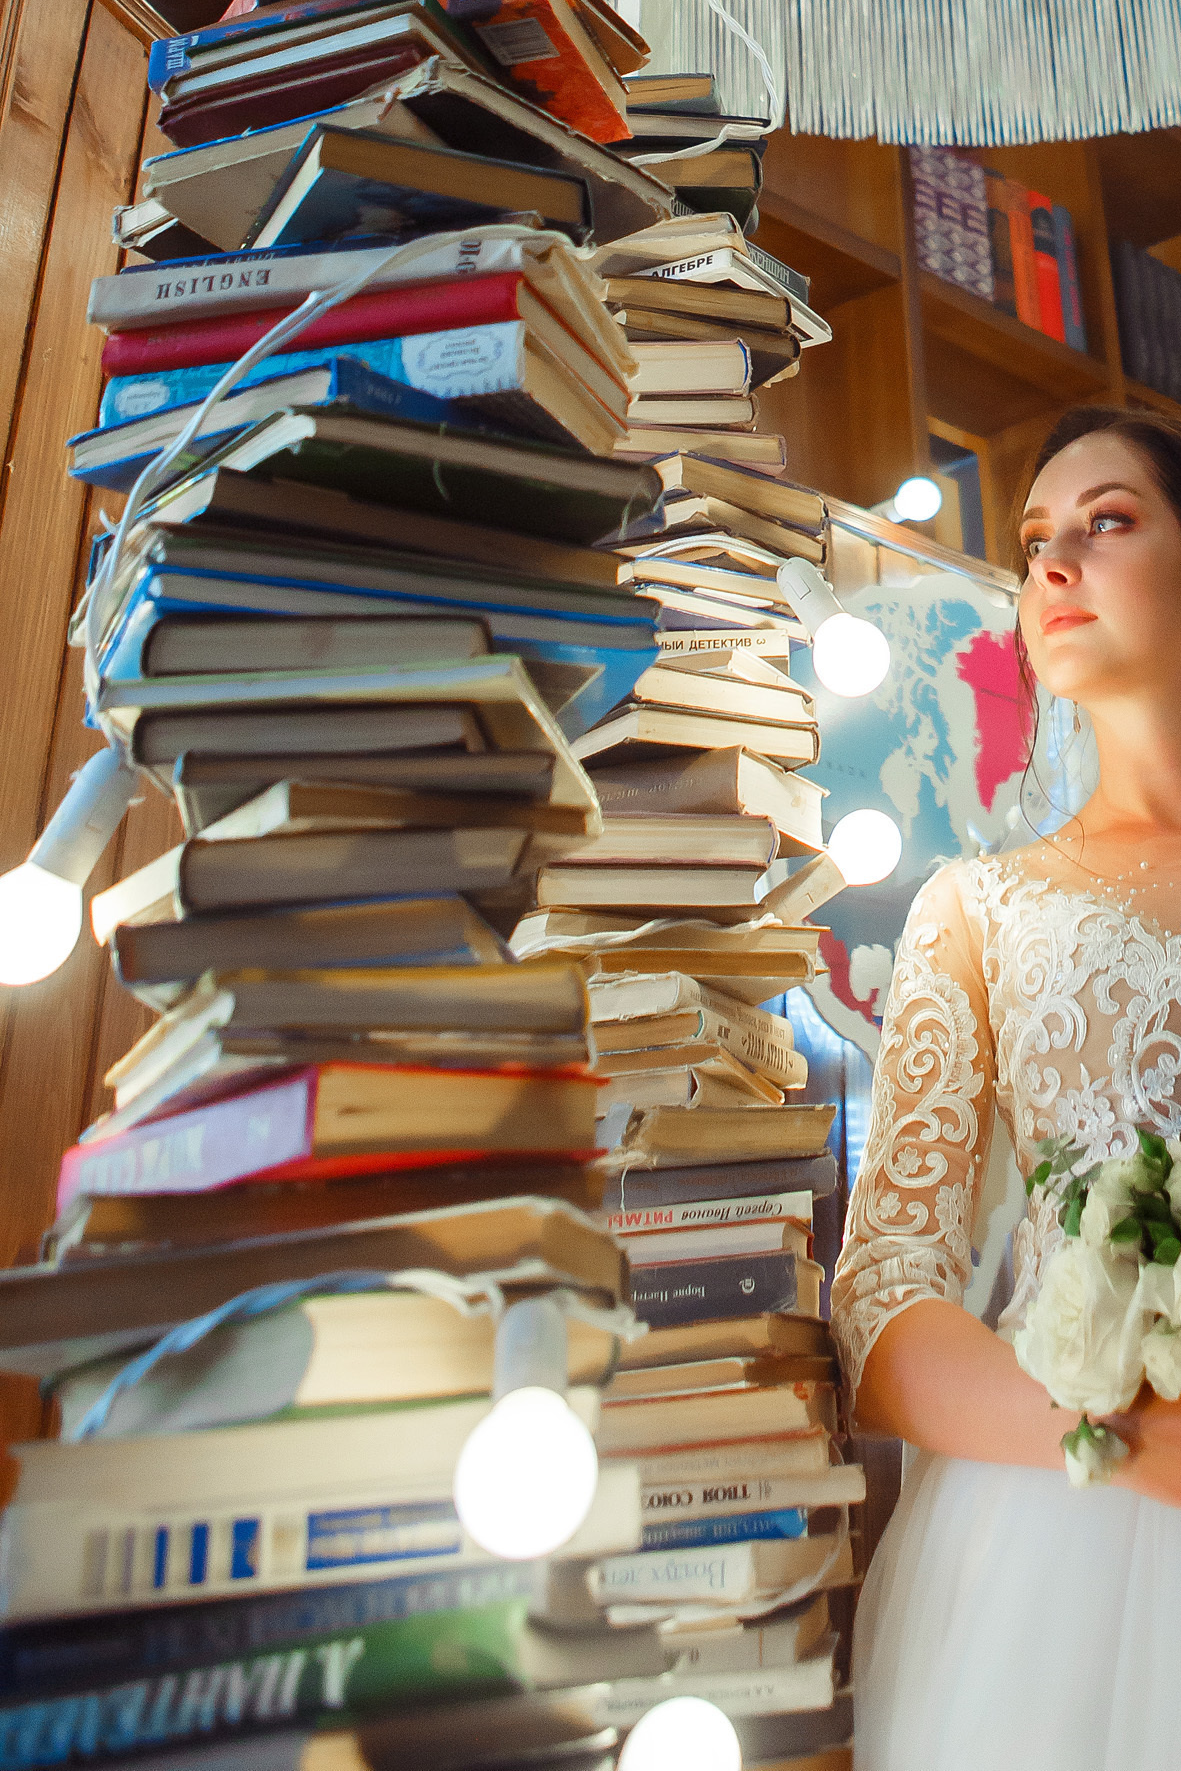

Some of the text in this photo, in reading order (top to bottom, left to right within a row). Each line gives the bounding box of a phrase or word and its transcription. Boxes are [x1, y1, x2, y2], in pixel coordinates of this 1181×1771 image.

[651, 255, 714, 278] АЛГЕБРЕ
[153, 268, 272, 301] ENGLISH
[688, 638, 752, 652] ДЕТЕКТИВ
[608, 1200, 784, 1229] Сергей Иванов РИТМЫ
[703, 1484, 751, 1504] ТВОЯ
